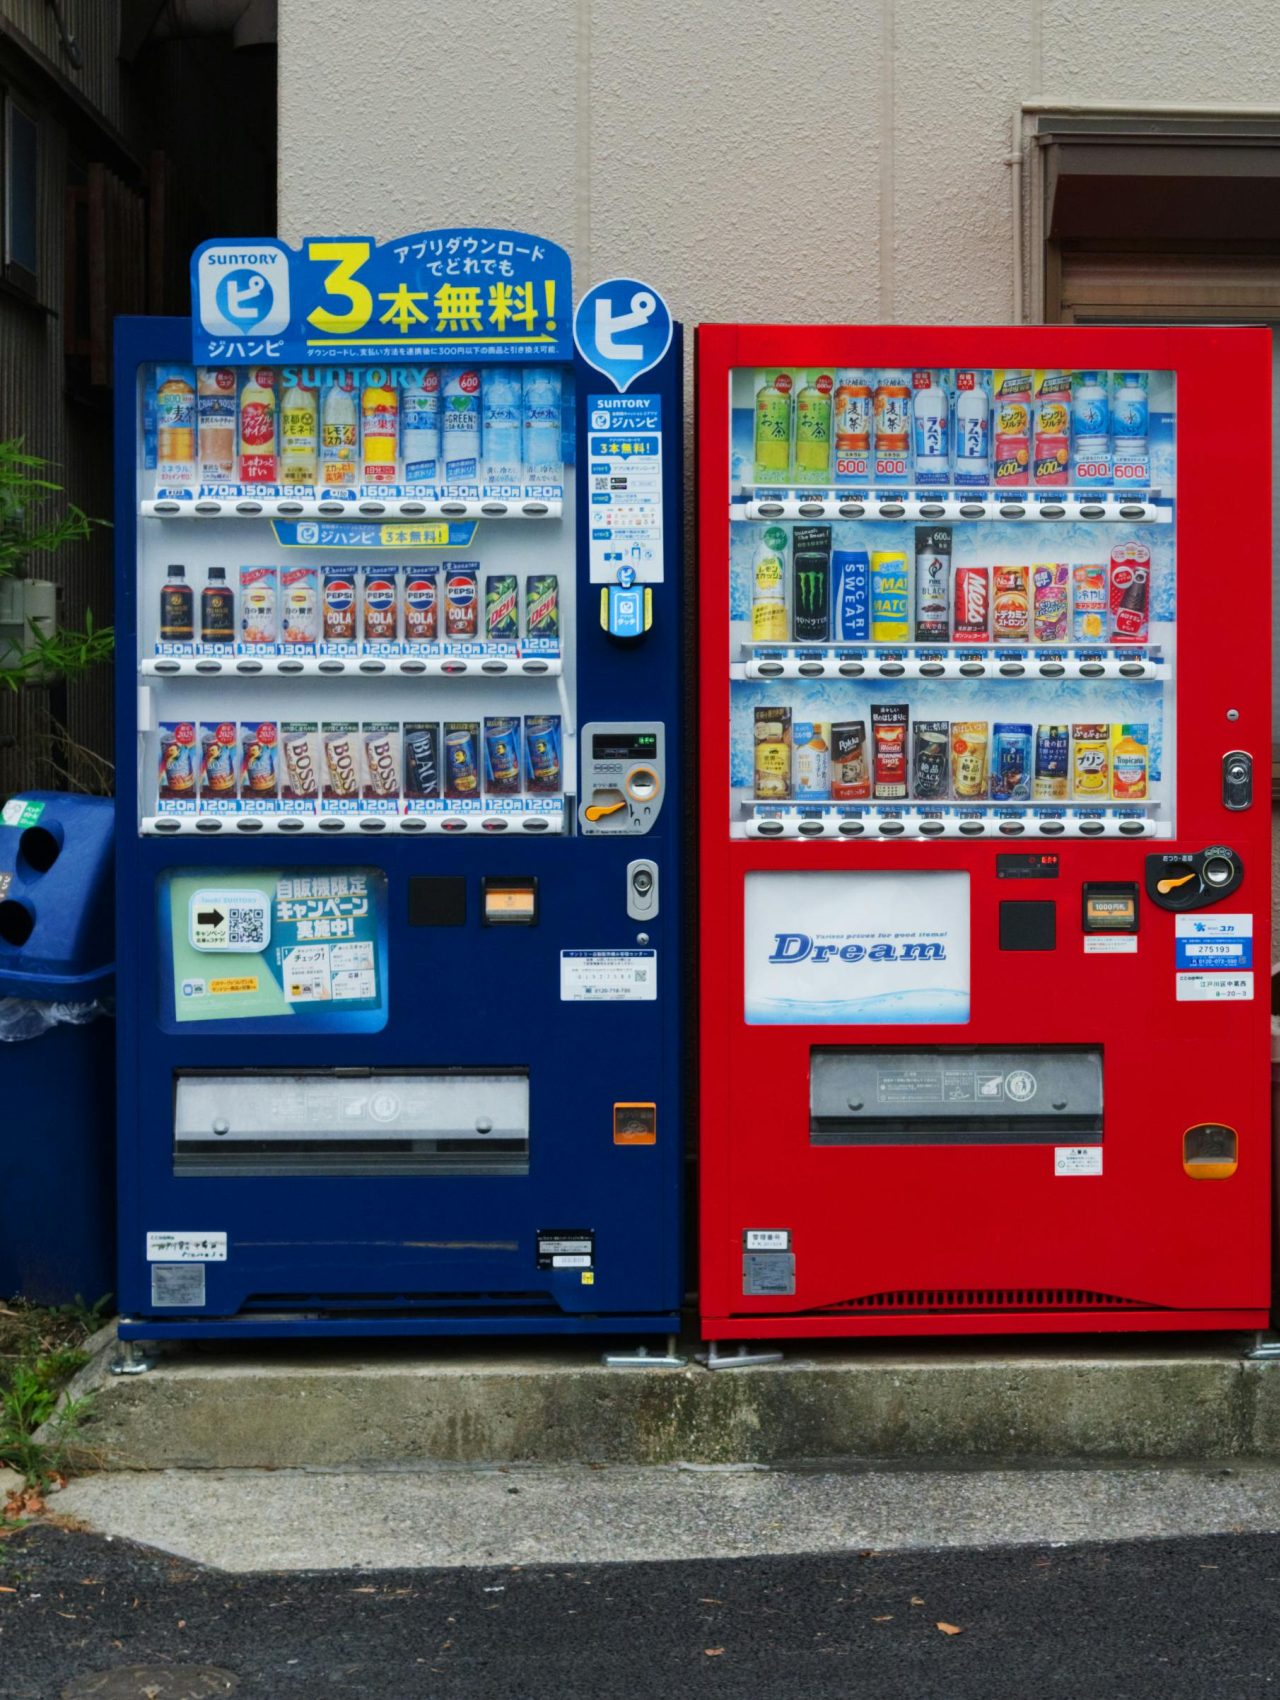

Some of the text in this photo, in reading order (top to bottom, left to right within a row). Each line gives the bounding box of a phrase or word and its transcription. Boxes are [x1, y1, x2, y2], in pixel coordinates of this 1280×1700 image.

[394, 236, 545, 263] アプリダウンロード
[208, 254, 277, 265] SUNTORY
[426, 257, 514, 276] でどれでも
[208, 340, 284, 358] ジハンピ
[597, 399, 651, 408] SUNTORY
[612, 417, 658, 428] ジハンピ
[321, 531, 375, 544] ジハンピ
[326, 592, 352, 600] PEPSI
[367, 592, 392, 600] PEPSI
[408, 592, 434, 600] PEPSI
[845, 564, 856, 629] SWEAT
[855, 564, 865, 636] POCARI
[1078, 590, 1105, 601] 冷やし
[327, 612, 352, 625] COLA
[368, 612, 392, 625] COLA
[409, 612, 434, 625] COLA
[448, 608, 473, 621] COLA
[293, 742, 316, 793] BOSS
[334, 742, 356, 793] BOSS
[374, 742, 397, 793] BOSS
[413, 738, 437, 794] BLACK
[159, 800, 194, 810] 120円
[202, 800, 237, 810] 120円
[240, 800, 275, 810] 120円
[279, 800, 313, 810] 120円
[322, 800, 358, 810] 120円
[361, 800, 396, 810] 120円
[409, 800, 444, 810] 120円
[446, 800, 481, 810] 120円
[487, 800, 521, 810] 120円
[526, 800, 561, 810] 120円
[277, 897, 368, 920] キャンペーン
[768, 933, 947, 964] Dream
